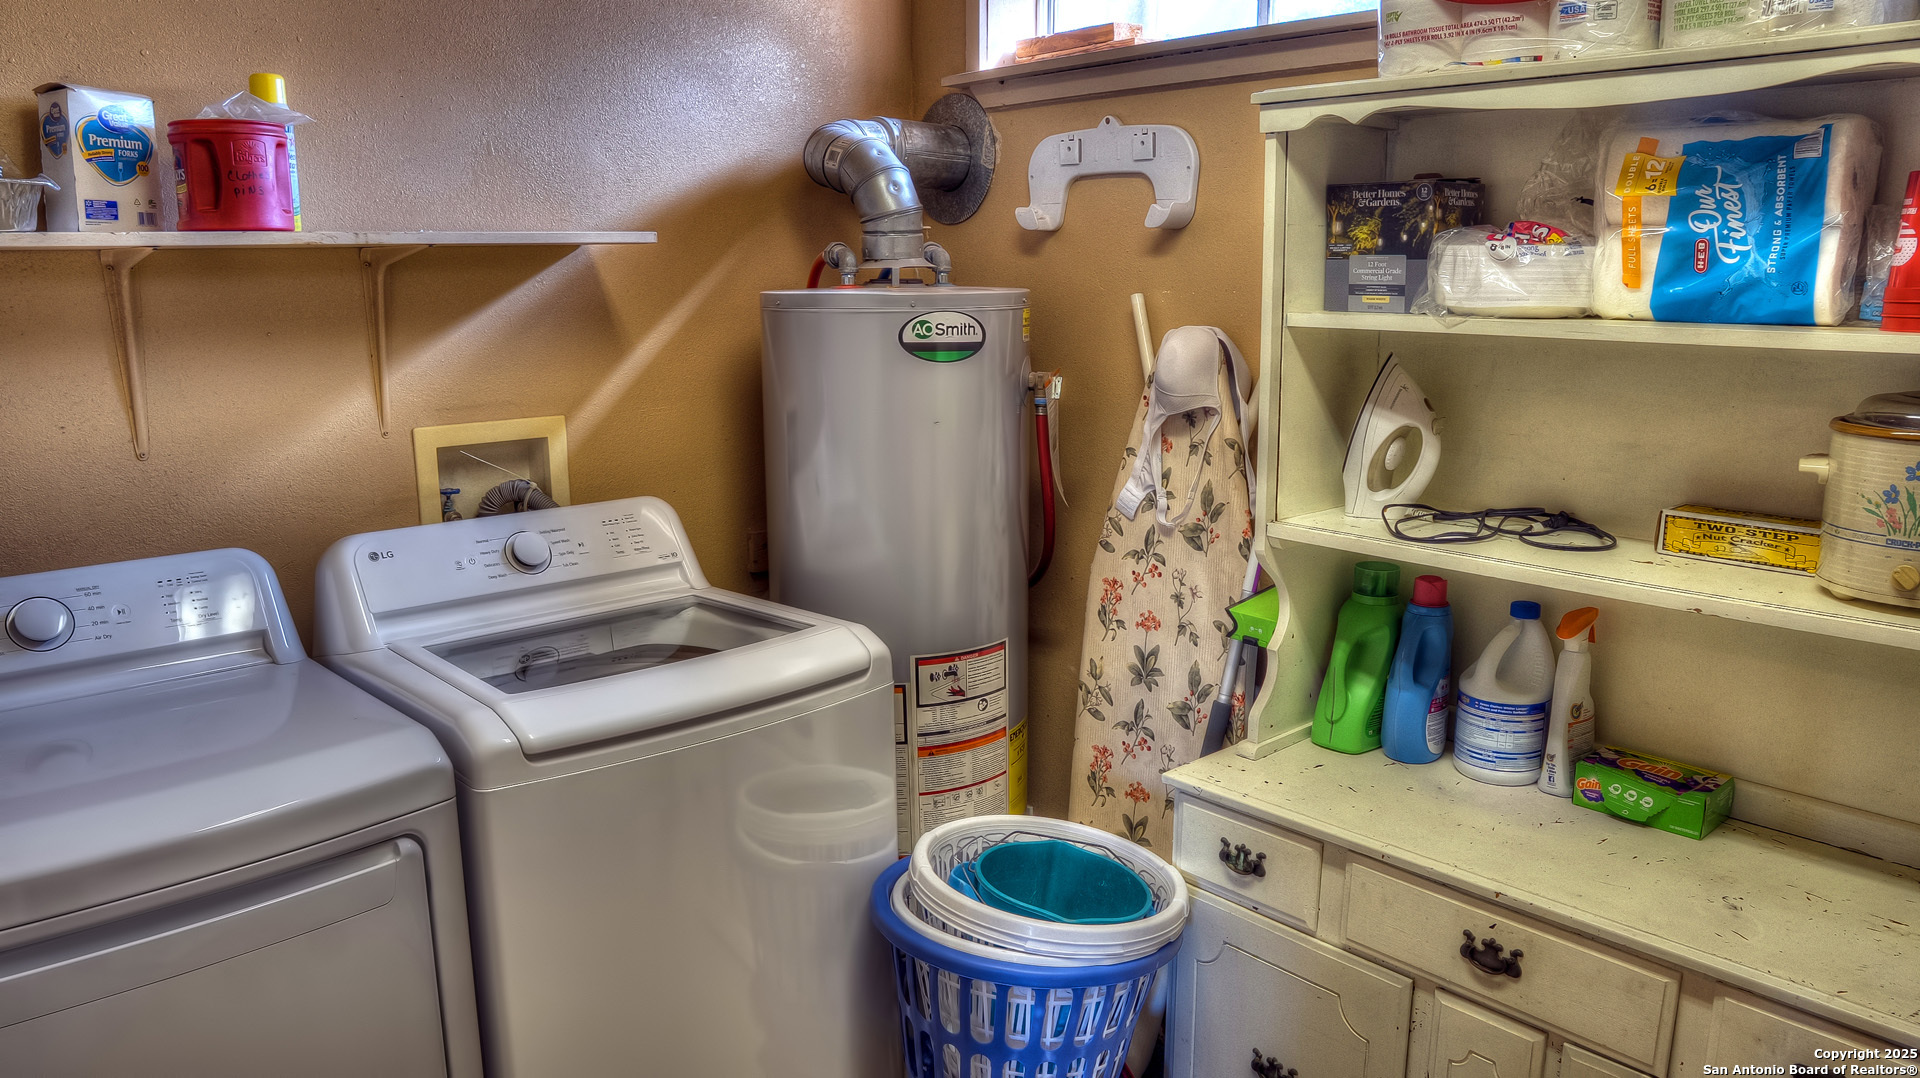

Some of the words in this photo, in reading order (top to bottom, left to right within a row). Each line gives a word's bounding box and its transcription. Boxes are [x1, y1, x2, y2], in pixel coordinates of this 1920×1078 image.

[1696, 12, 1713, 21] SHEETS
[1714, 10, 1723, 18] PER
[1402, 28, 1427, 37] BATHROOM
[101, 110, 128, 122] Great
[88, 134, 143, 150] Premium
[118, 149, 138, 158] FORKS
[236, 151, 266, 164] Folgers
[138, 164, 149, 172] 100
[1624, 155, 1640, 193] DOUBLE
[1645, 160, 1666, 180] 12
[1774, 155, 1787, 216] ABSORBENT
[1352, 190, 1377, 198] Better
[1378, 189, 1406, 198] Homes
[1444, 188, 1460, 198] Better
[1461, 189, 1478, 198] Homes
[1688, 184, 1722, 233] Our
[1713, 166, 1752, 264] Finest
[1628, 206, 1637, 242] SHEETS
[1767, 230, 1782, 273] STRONG
[1694, 522, 1800, 541] TWO-STEP
[1730, 536, 1782, 549] Cracker
[381, 550, 394, 559] LG
[1616, 758, 1683, 780] Gain
[1576, 777, 1602, 790] Gain
